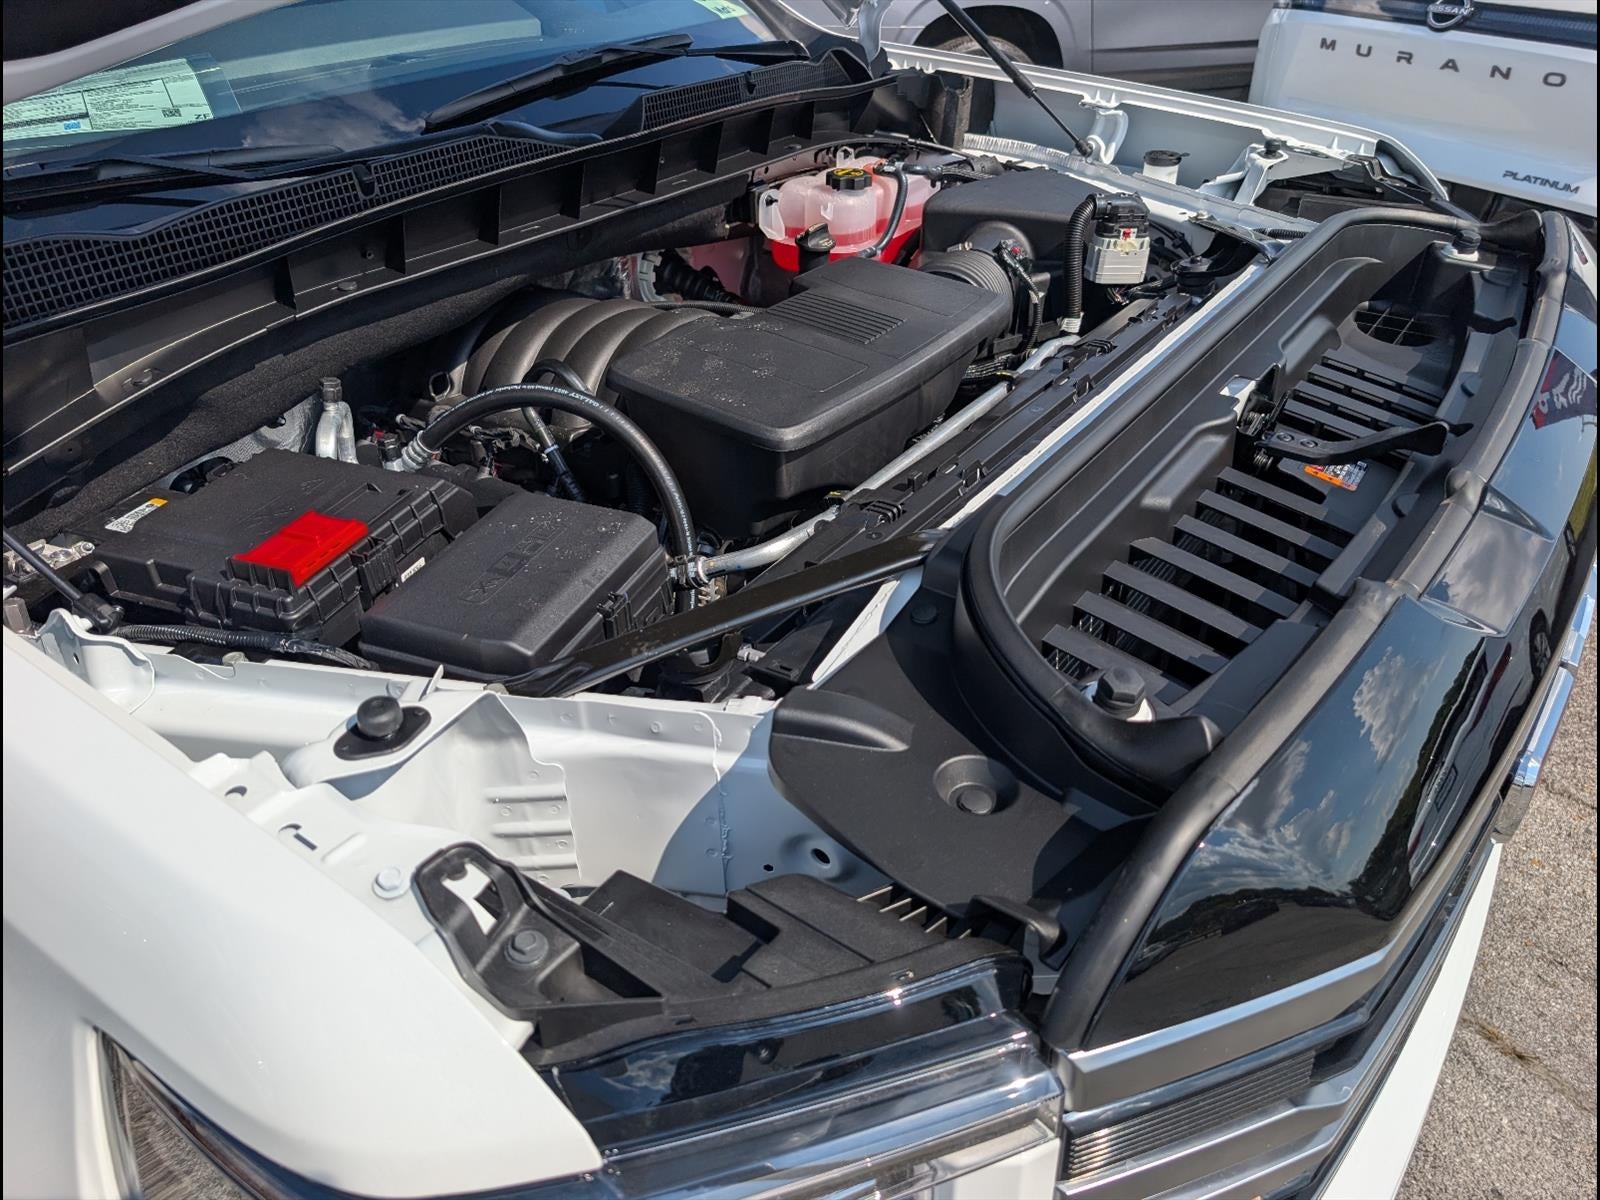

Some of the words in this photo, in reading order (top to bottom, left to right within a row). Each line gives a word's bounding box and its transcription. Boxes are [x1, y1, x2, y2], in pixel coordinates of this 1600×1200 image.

[1427, 4, 1470, 15] NISSAN
[1319, 37, 1567, 88] MURANO
[1502, 170, 1580, 195] PLATINUM
